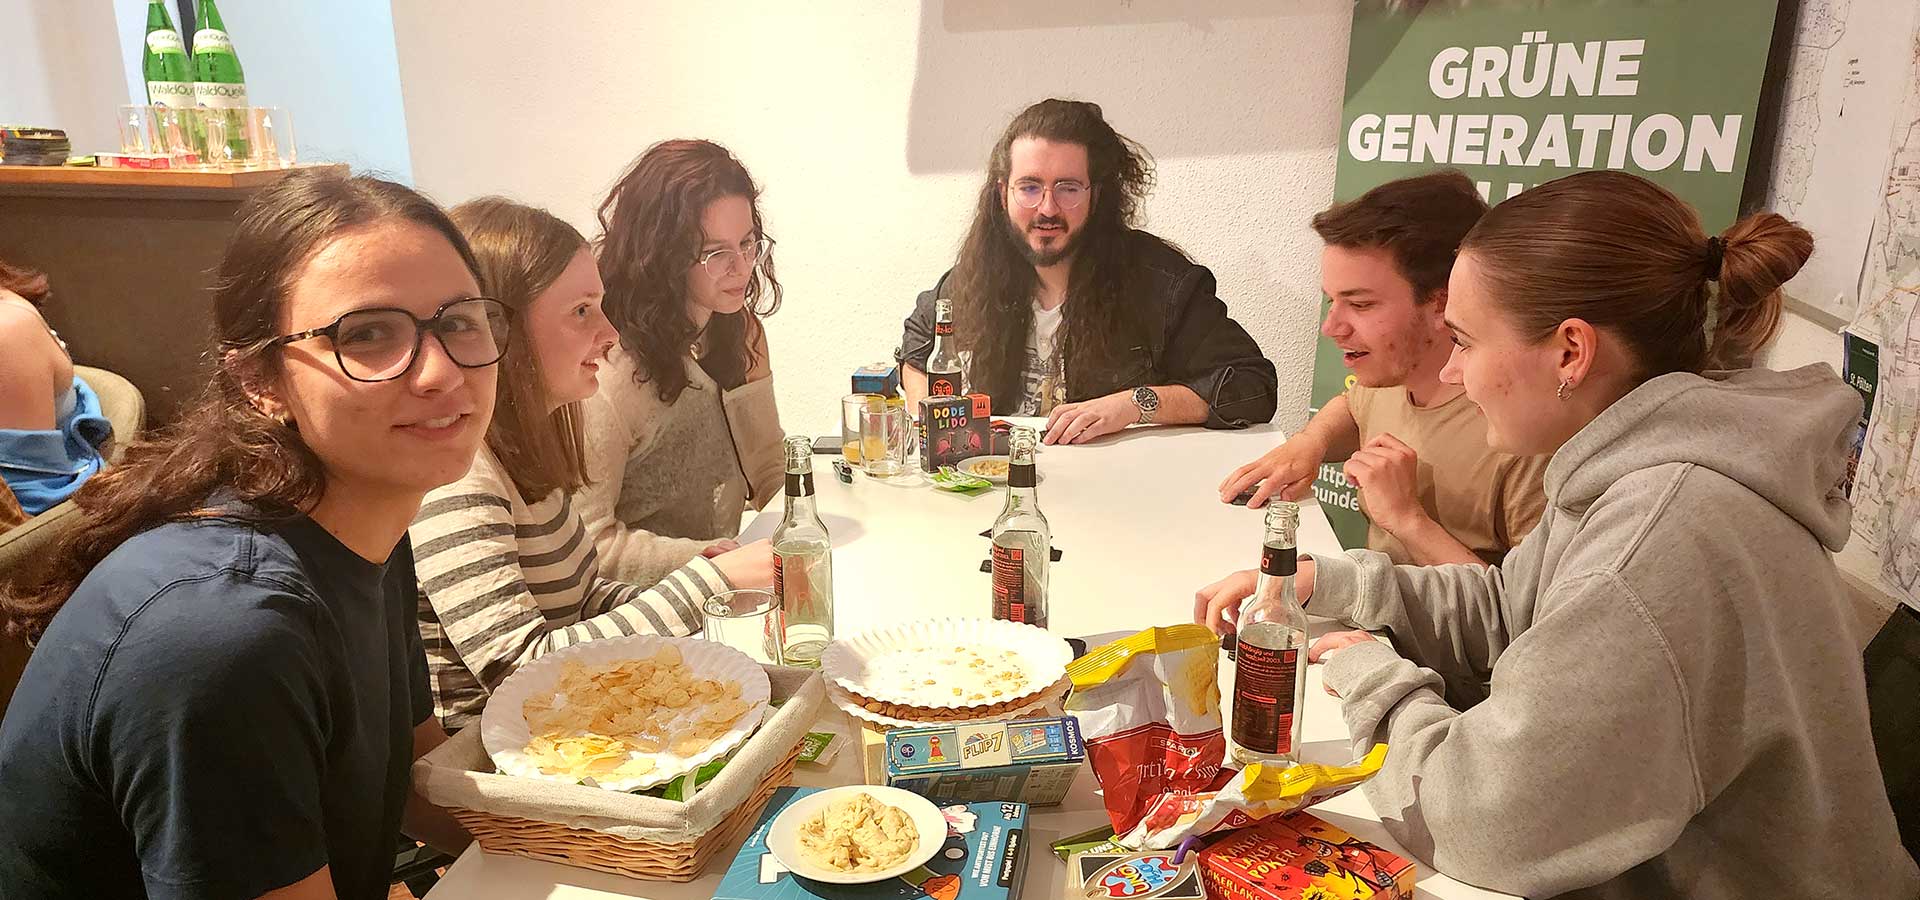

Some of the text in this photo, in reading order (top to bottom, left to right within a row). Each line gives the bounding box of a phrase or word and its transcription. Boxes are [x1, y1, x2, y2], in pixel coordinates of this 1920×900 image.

[1429, 31, 1646, 99] GRÜNE
[1346, 113, 1743, 173] GENERATION
[933, 406, 965, 419] DODE
[938, 417, 967, 429] LIDO
[1066, 720, 1079, 755] KOSMOS
[1159, 739, 1186, 752] SPAR
[1216, 833, 1267, 862] KAKER
[1233, 843, 1280, 870] LAKEN
[1247, 849, 1303, 880] POKER
[1120, 865, 1153, 893] UNO
[1200, 865, 1263, 900] KAKERLAKE
[1204, 879, 1232, 900] OKER
